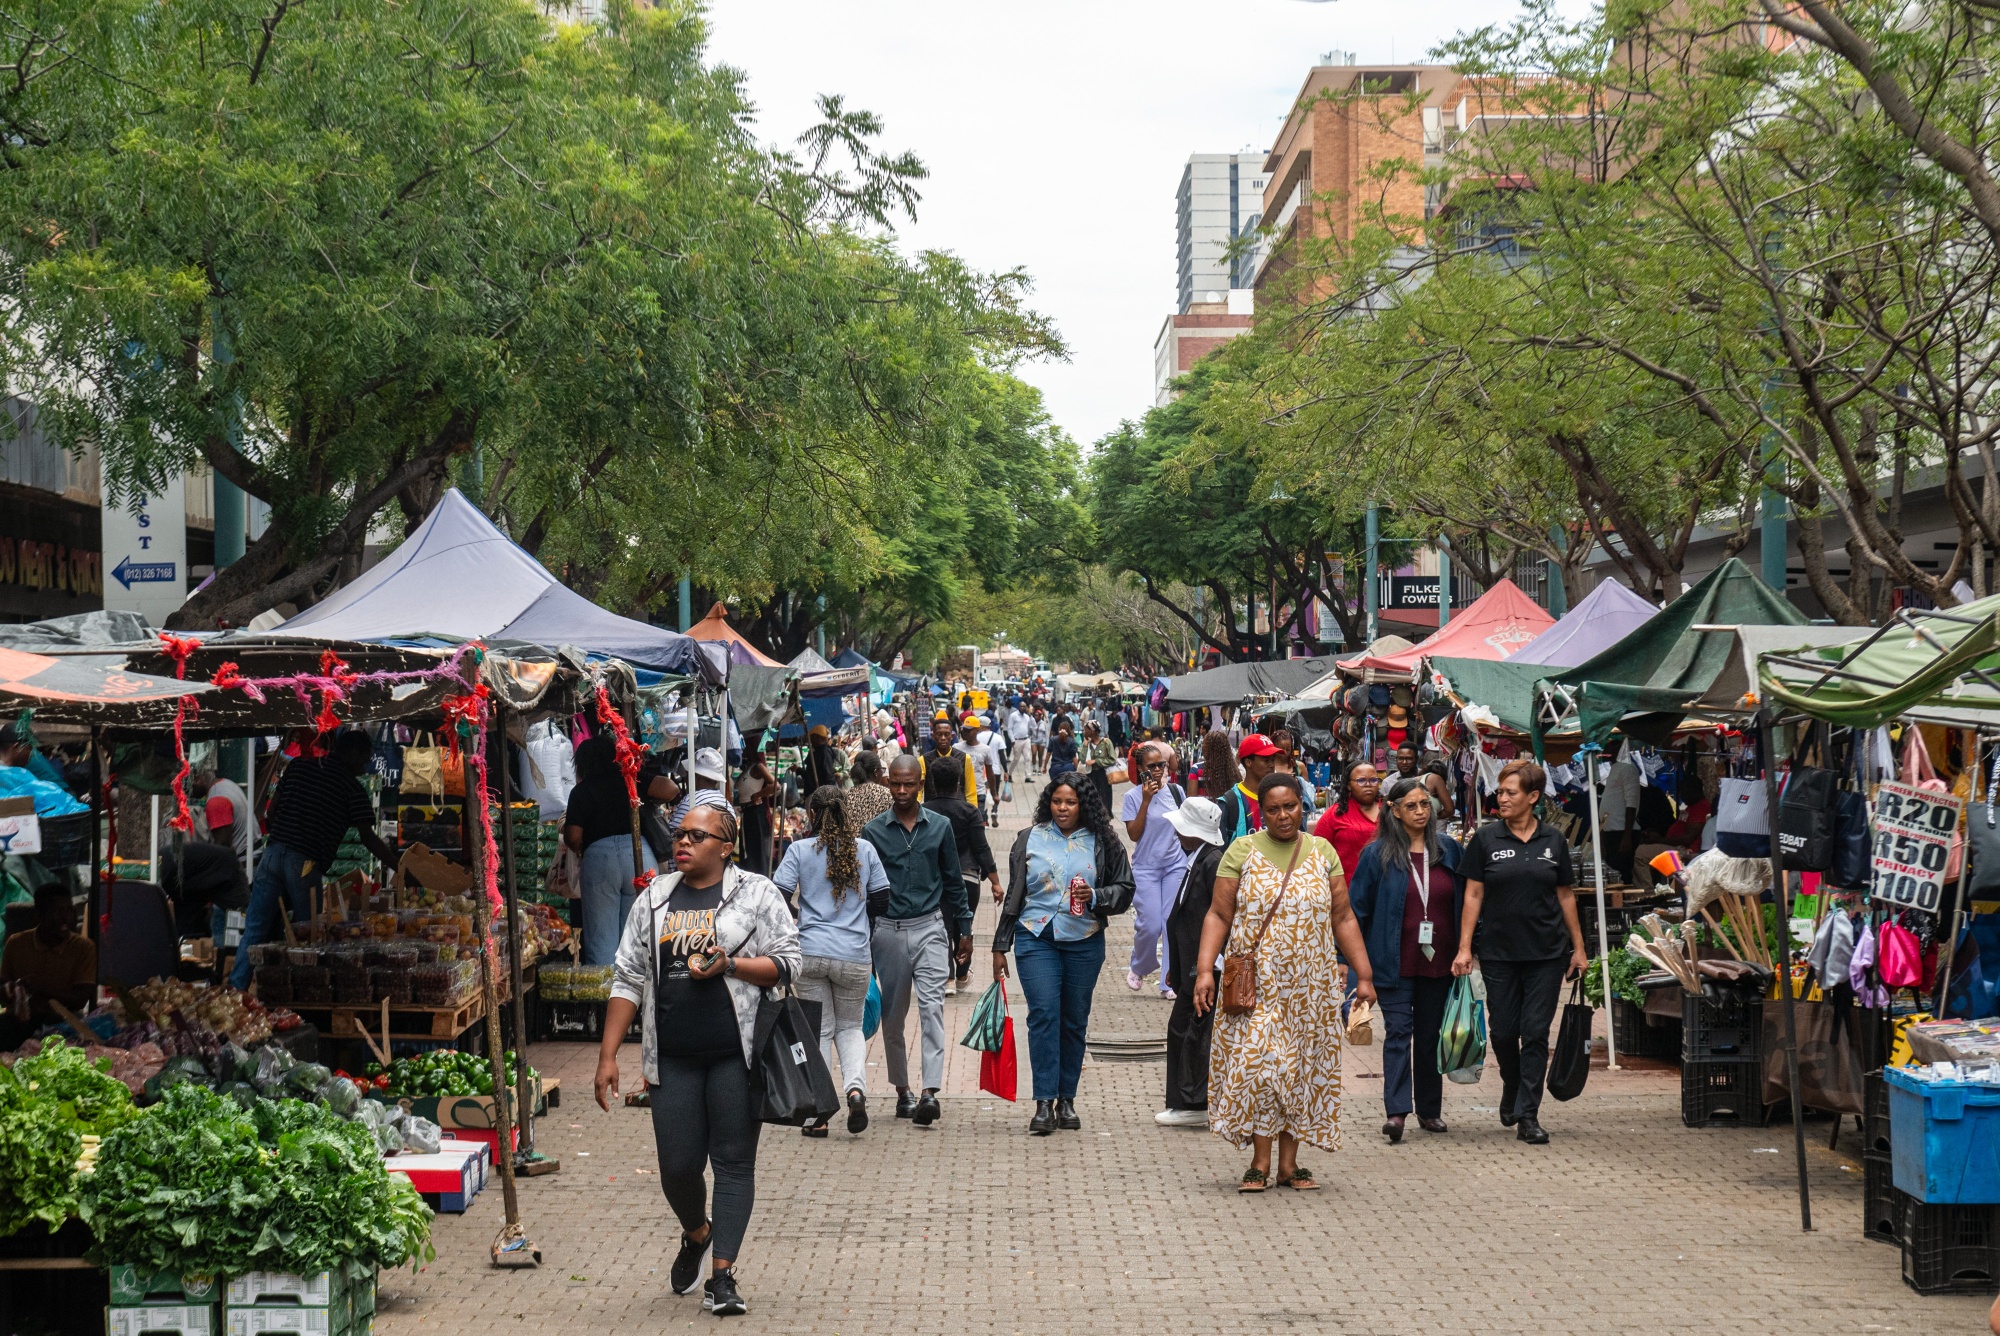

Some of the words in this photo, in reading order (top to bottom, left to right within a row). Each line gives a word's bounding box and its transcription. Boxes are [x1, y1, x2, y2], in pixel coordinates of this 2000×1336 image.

[124, 569, 141, 580] (012)
[143, 568, 156, 579] 326
[156, 567, 173, 578] 7168
[1403, 585, 1441, 594] FILKE
[1402, 594, 1453, 604] TOWES
[1914, 791, 1960, 808] PROTECTOR
[1878, 790, 1957, 831] R20
[1898, 820, 1915, 830] ALL
[1779, 832, 1807, 847] EDBAT
[1491, 849, 1516, 861] CSD
[1873, 831, 1948, 872] R50
[1875, 858, 1936, 880] PRIVACY
[661, 909, 717, 936] ROOK
[670, 929, 716, 956] Nets
